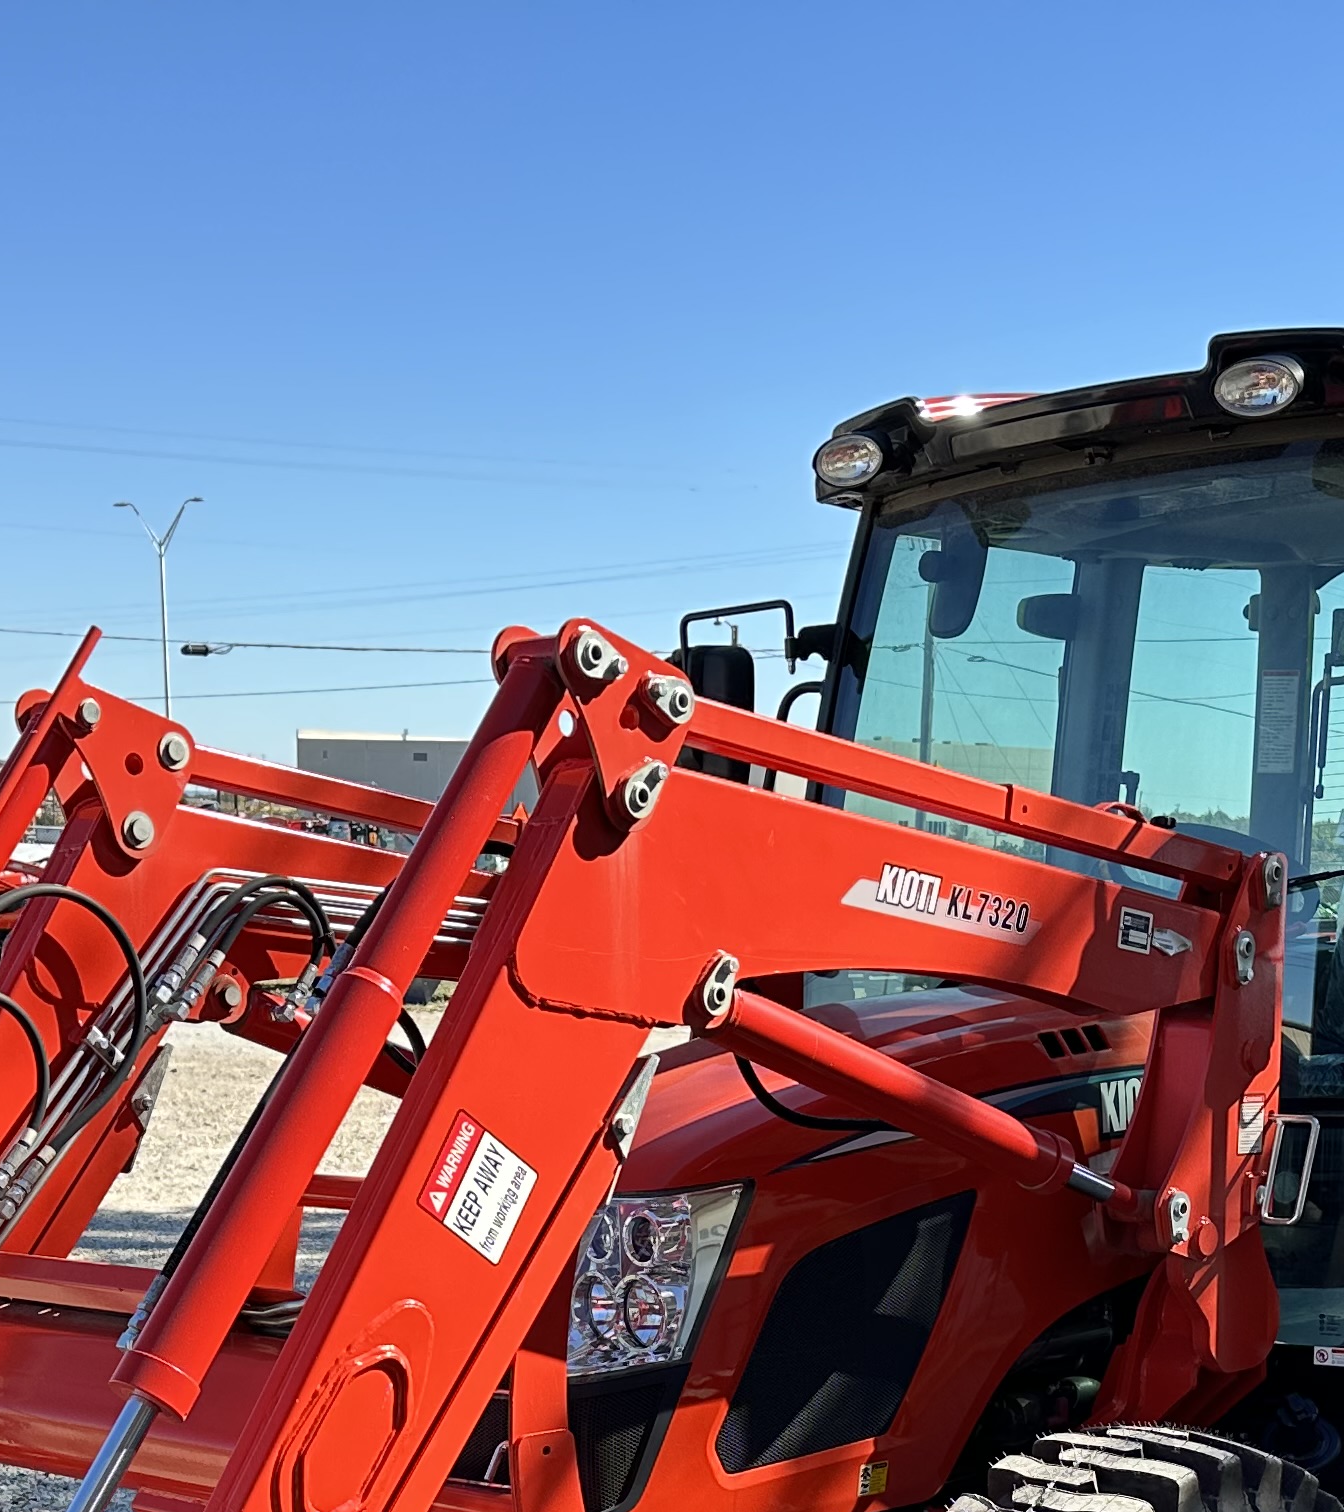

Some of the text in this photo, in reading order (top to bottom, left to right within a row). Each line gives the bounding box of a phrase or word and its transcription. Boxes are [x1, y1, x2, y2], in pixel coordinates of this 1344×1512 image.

[876, 863, 1030, 935] KIOTI KL7320
[1100, 1077, 1143, 1134] KIO
[436, 1121, 476, 1189] WARNING
[453, 1142, 506, 1237] KEEP AWAY
[479, 1165, 528, 1253] from working area
